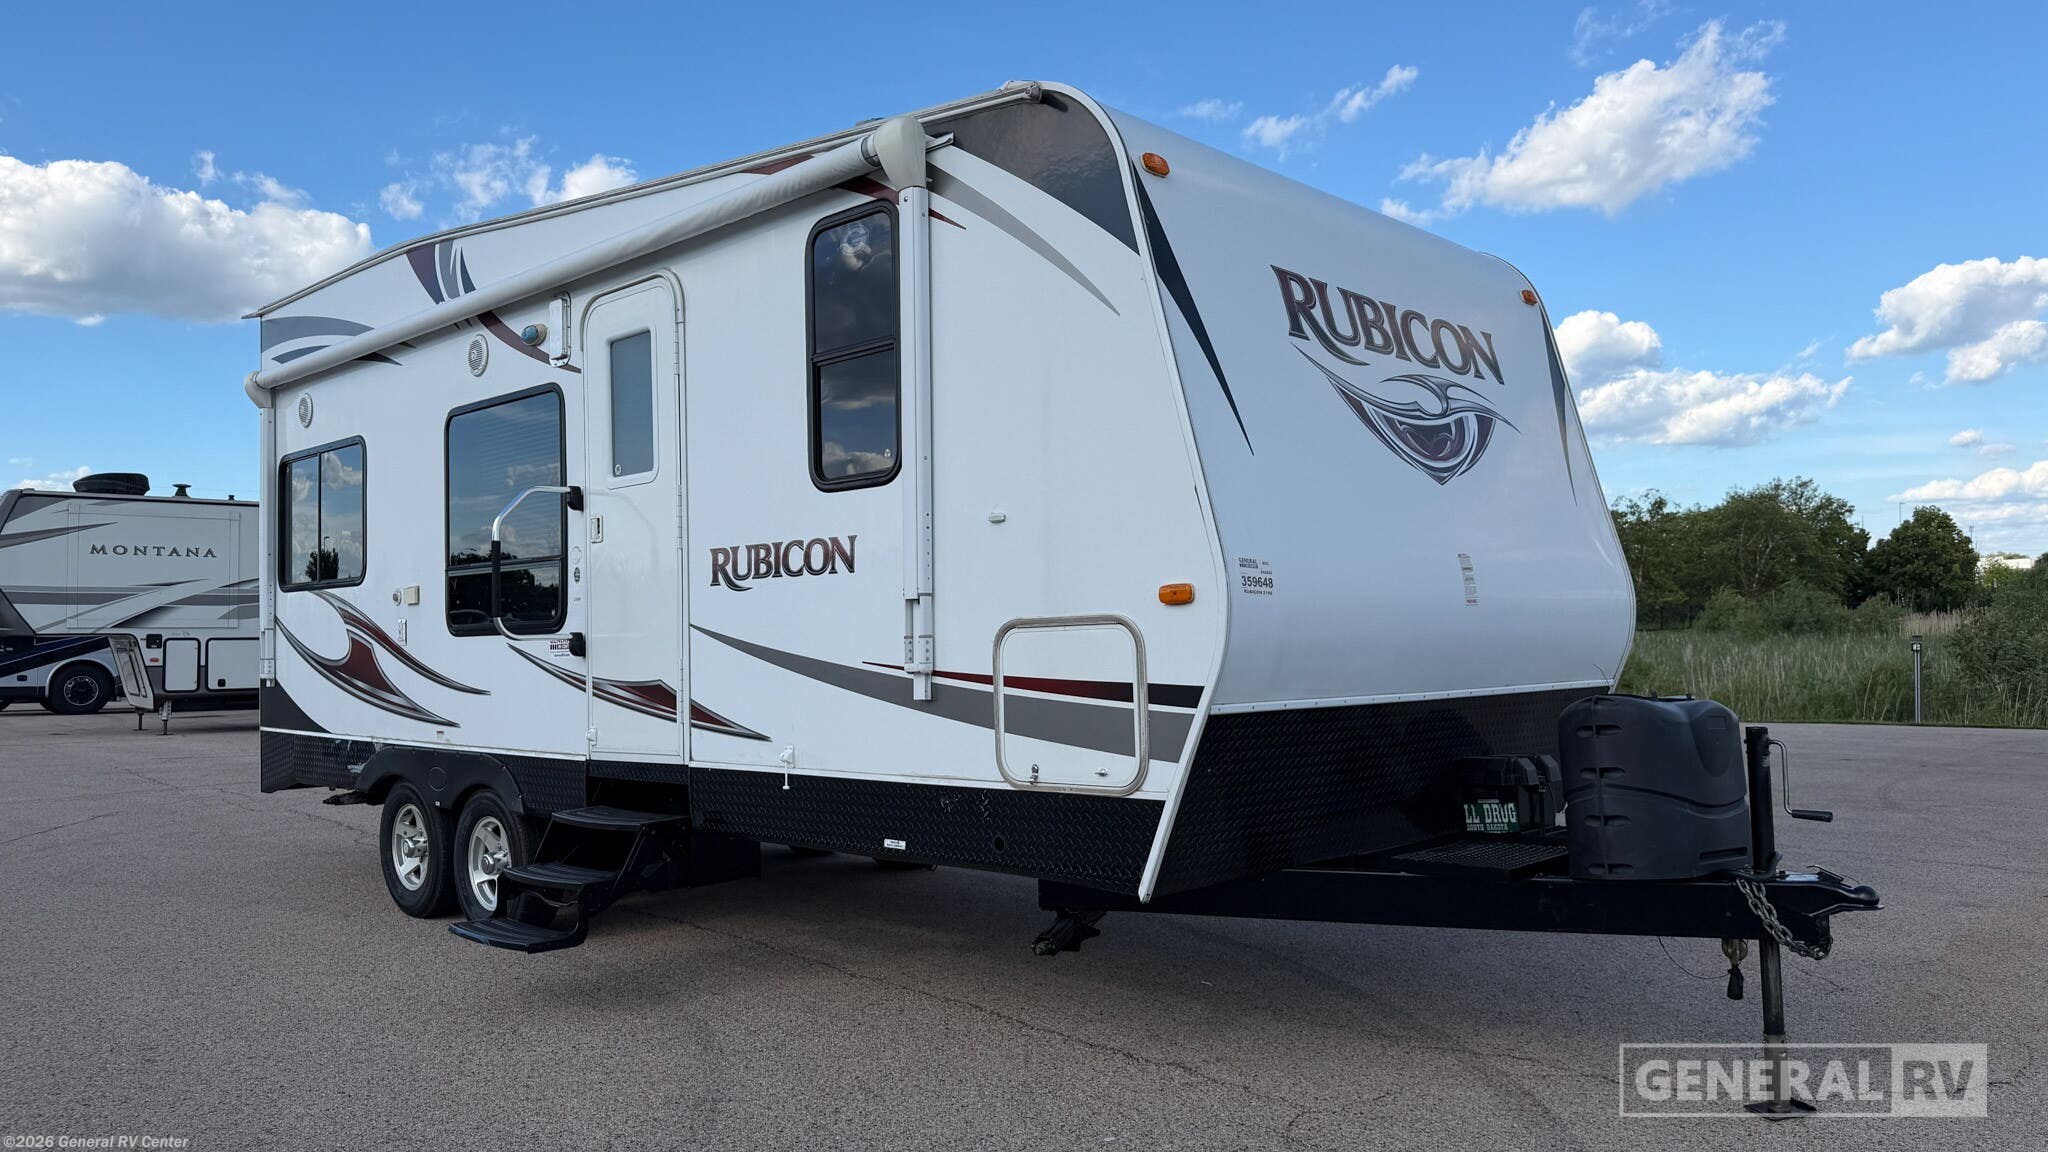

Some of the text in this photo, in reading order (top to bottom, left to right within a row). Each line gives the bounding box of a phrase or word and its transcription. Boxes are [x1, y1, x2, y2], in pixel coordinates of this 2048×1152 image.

[1270, 264, 1505, 386] RUBICON
[89, 543, 217, 558] MONTANA
[709, 534, 858, 592] RUBICON
[1241, 575, 1274, 589] 359648
[1483, 802, 1517, 823] DRUG
